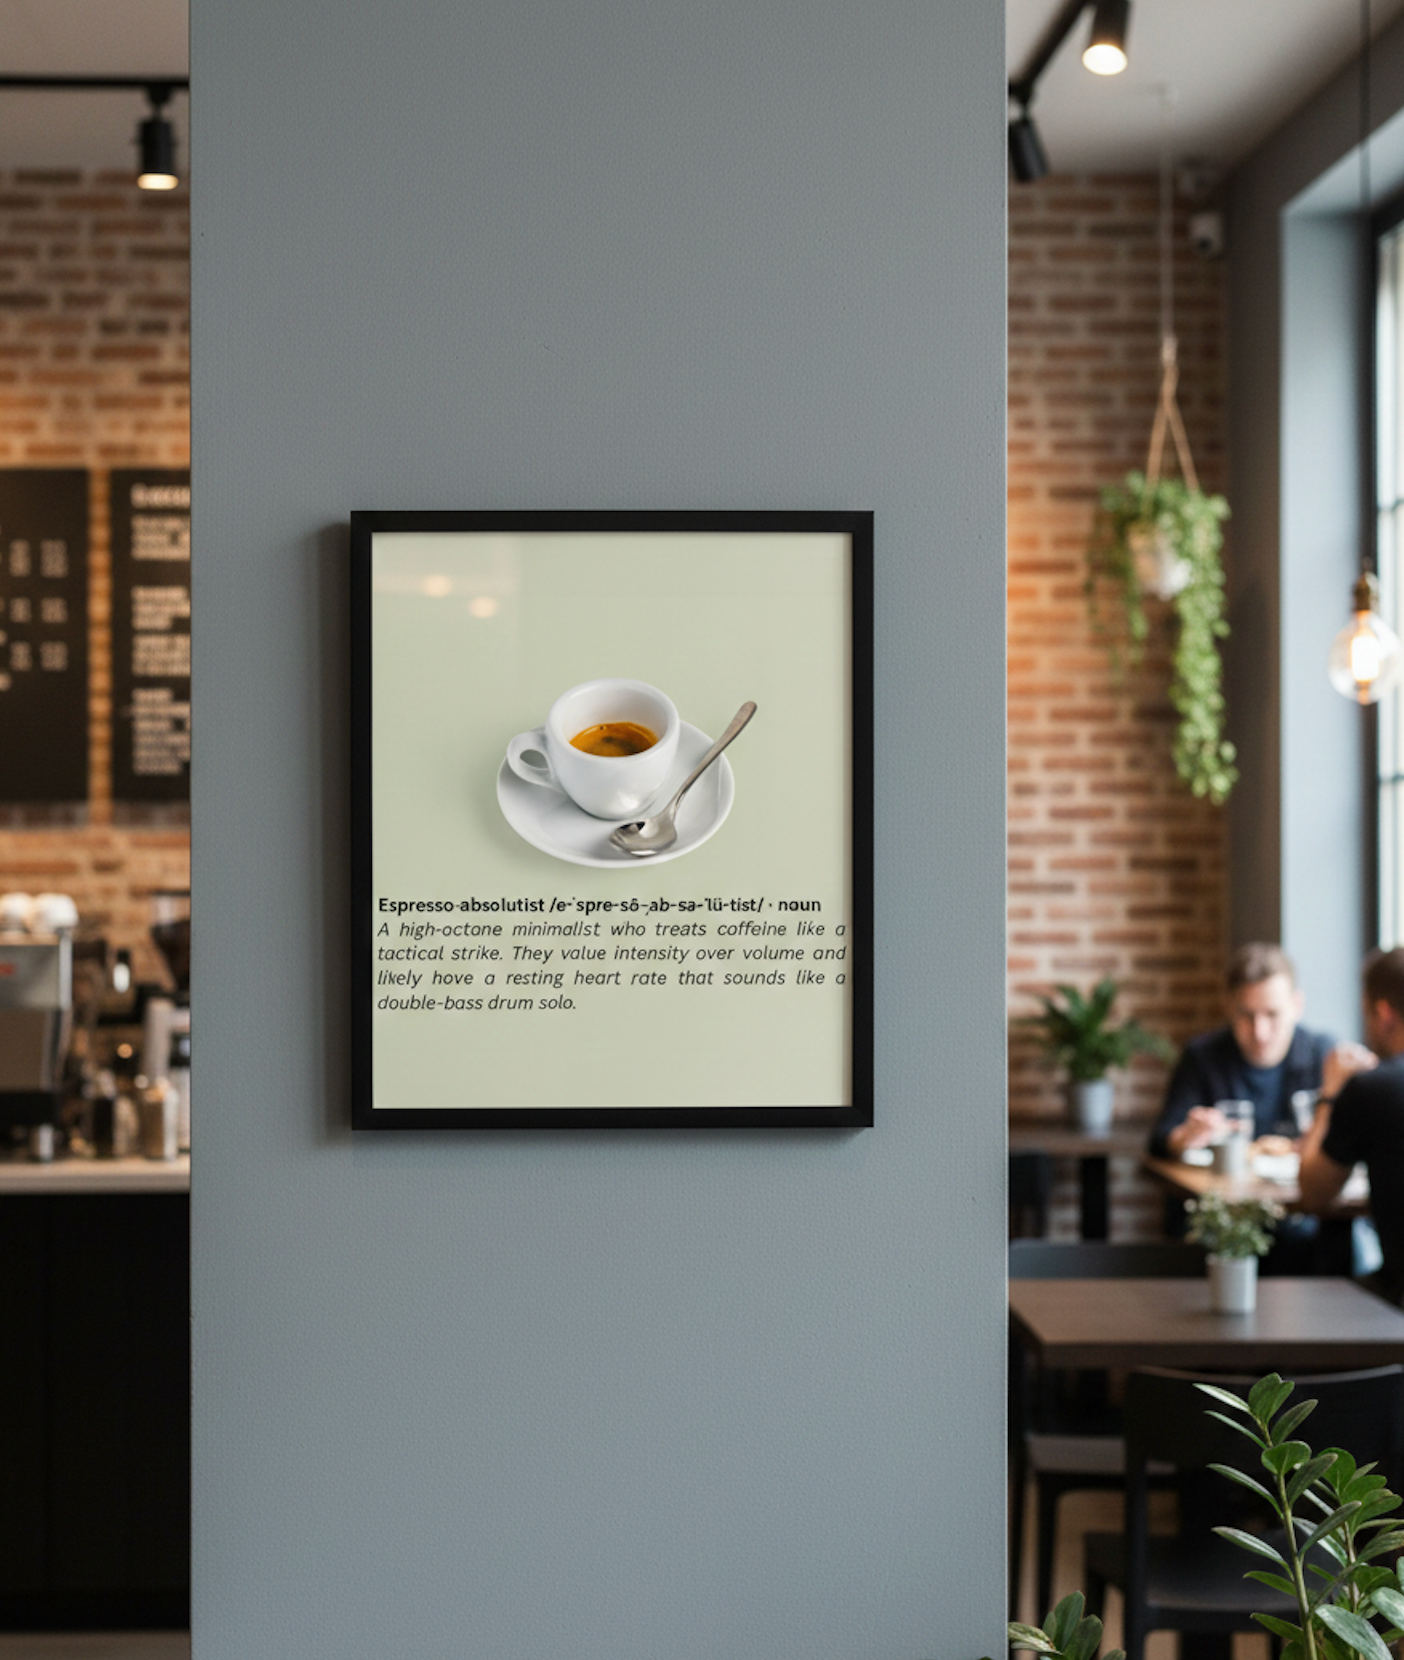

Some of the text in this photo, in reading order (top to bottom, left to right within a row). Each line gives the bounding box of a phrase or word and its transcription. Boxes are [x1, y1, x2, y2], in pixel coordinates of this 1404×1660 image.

[378, 896, 545, 917] Espresso-absolutist
[777, 900, 822, 912] noun
[376, 922, 390, 937] A
[610, 920, 646, 937] who
[655, 922, 707, 937] treats
[796, 920, 826, 936] like
[835, 924, 847, 937] a
[378, 944, 847, 965] tactical strike. They value intensity over volume and
[377, 968, 423, 990] likely
[484, 973, 496, 986] a
[505, 969, 565, 989] resting
[573, 969, 622, 986] heart
[630, 971, 667, 986] rate
[678, 970, 714, 986] that
[723, 969, 786, 986] sounds
[796, 969, 826, 985] like
[835, 972, 847, 986] a
[377, 994, 576, 1011] double-bass drum solo.
